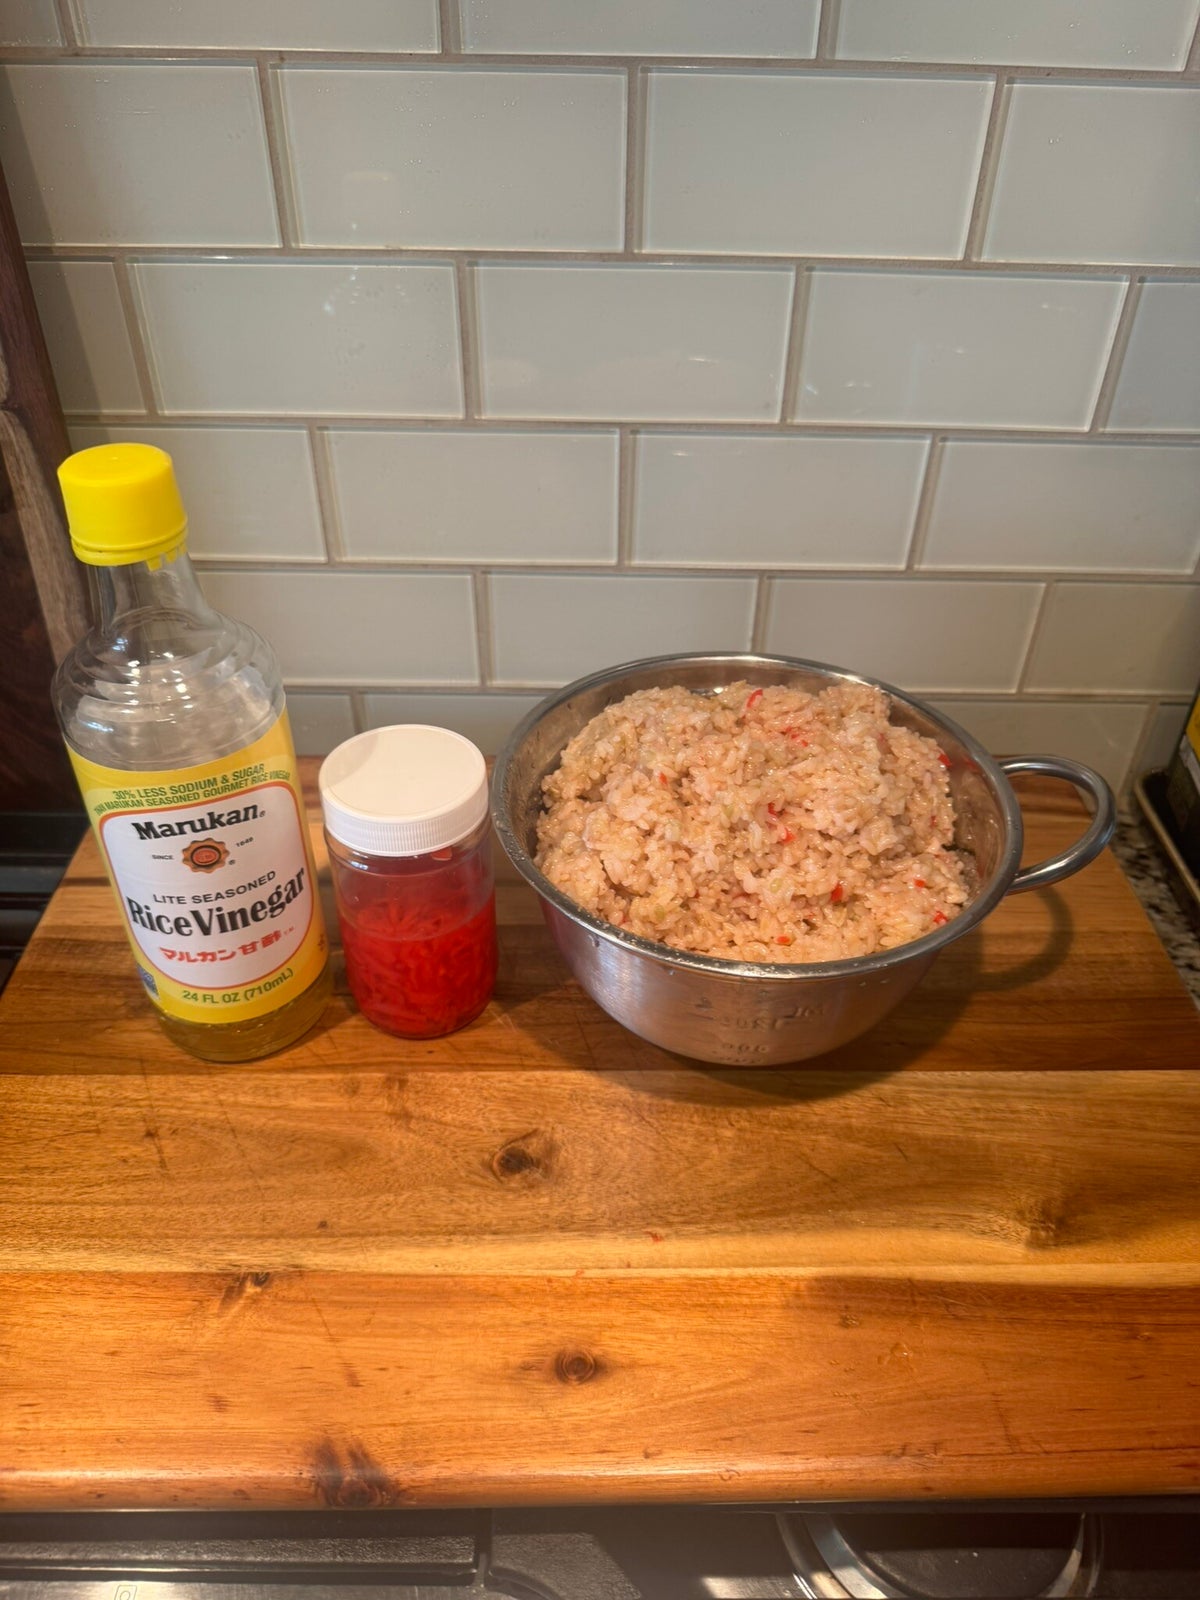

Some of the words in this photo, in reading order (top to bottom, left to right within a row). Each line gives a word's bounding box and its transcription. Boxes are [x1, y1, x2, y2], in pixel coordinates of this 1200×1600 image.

[104, 799, 145, 811] MARUKAN
[145, 792, 200, 806] SEASONED
[203, 778, 250, 798] GOURMET
[250, 772, 268, 785] RICE
[112, 789, 136, 800] 30%
[136, 786, 167, 798] LESS
[169, 777, 218, 796] SODIUM
[220, 774, 229, 785] &
[231, 763, 265, 781] SUGAR
[131, 803, 258, 840] Marukan
[126, 896, 193, 937] Rice
[190, 867, 306, 937] Vinegar
[153, 893, 188, 905] LITE
[191, 870, 277, 905] SEASONED
[182, 989, 199, 1002] 24
[203, 993, 219, 1004] FL
[222, 991, 240, 1004] OZ
[244, 967, 295, 1001] (710mL)
